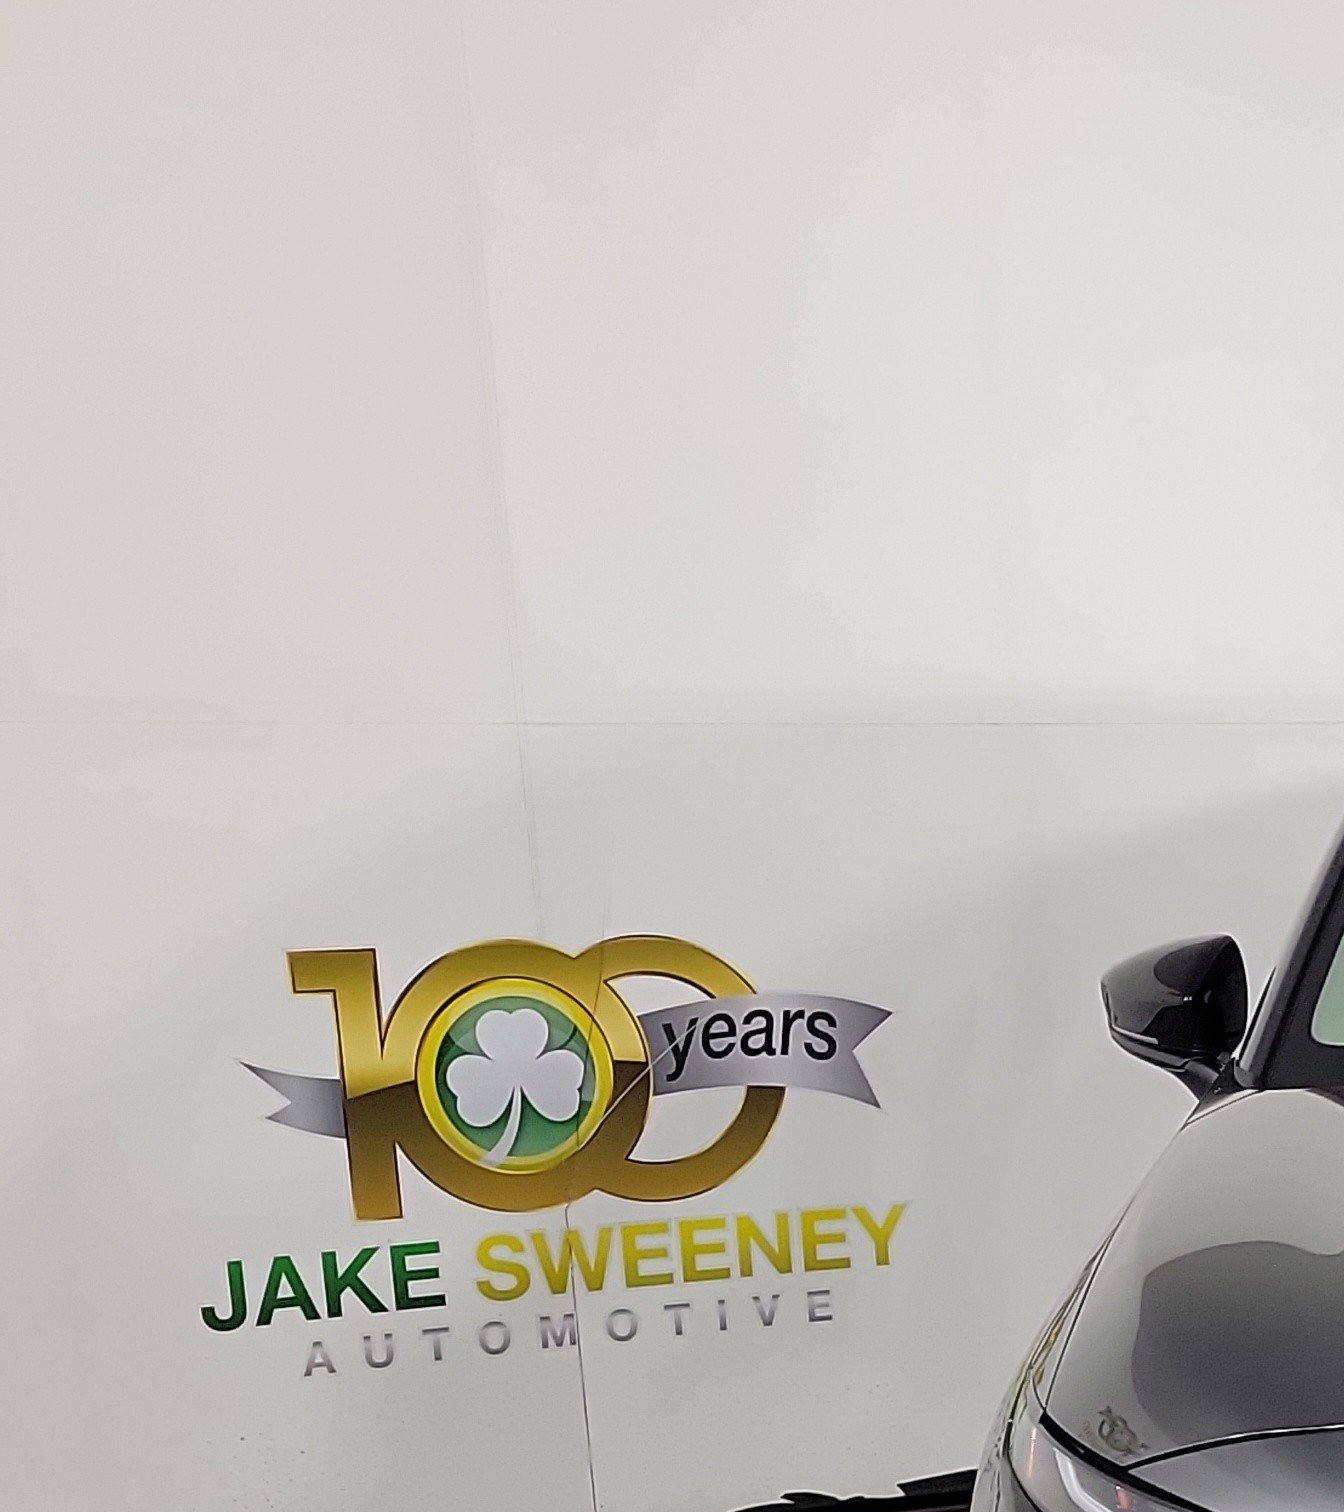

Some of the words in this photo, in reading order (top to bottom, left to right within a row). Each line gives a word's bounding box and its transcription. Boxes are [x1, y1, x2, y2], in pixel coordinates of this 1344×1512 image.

[287, 934, 785, 1222] 100
[662, 1007, 838, 1083] years
[200, 1240, 448, 1332] JAKE
[474, 1203, 907, 1302] SWEENEY
[303, 1289, 834, 1378] AUTOMOTIVE
